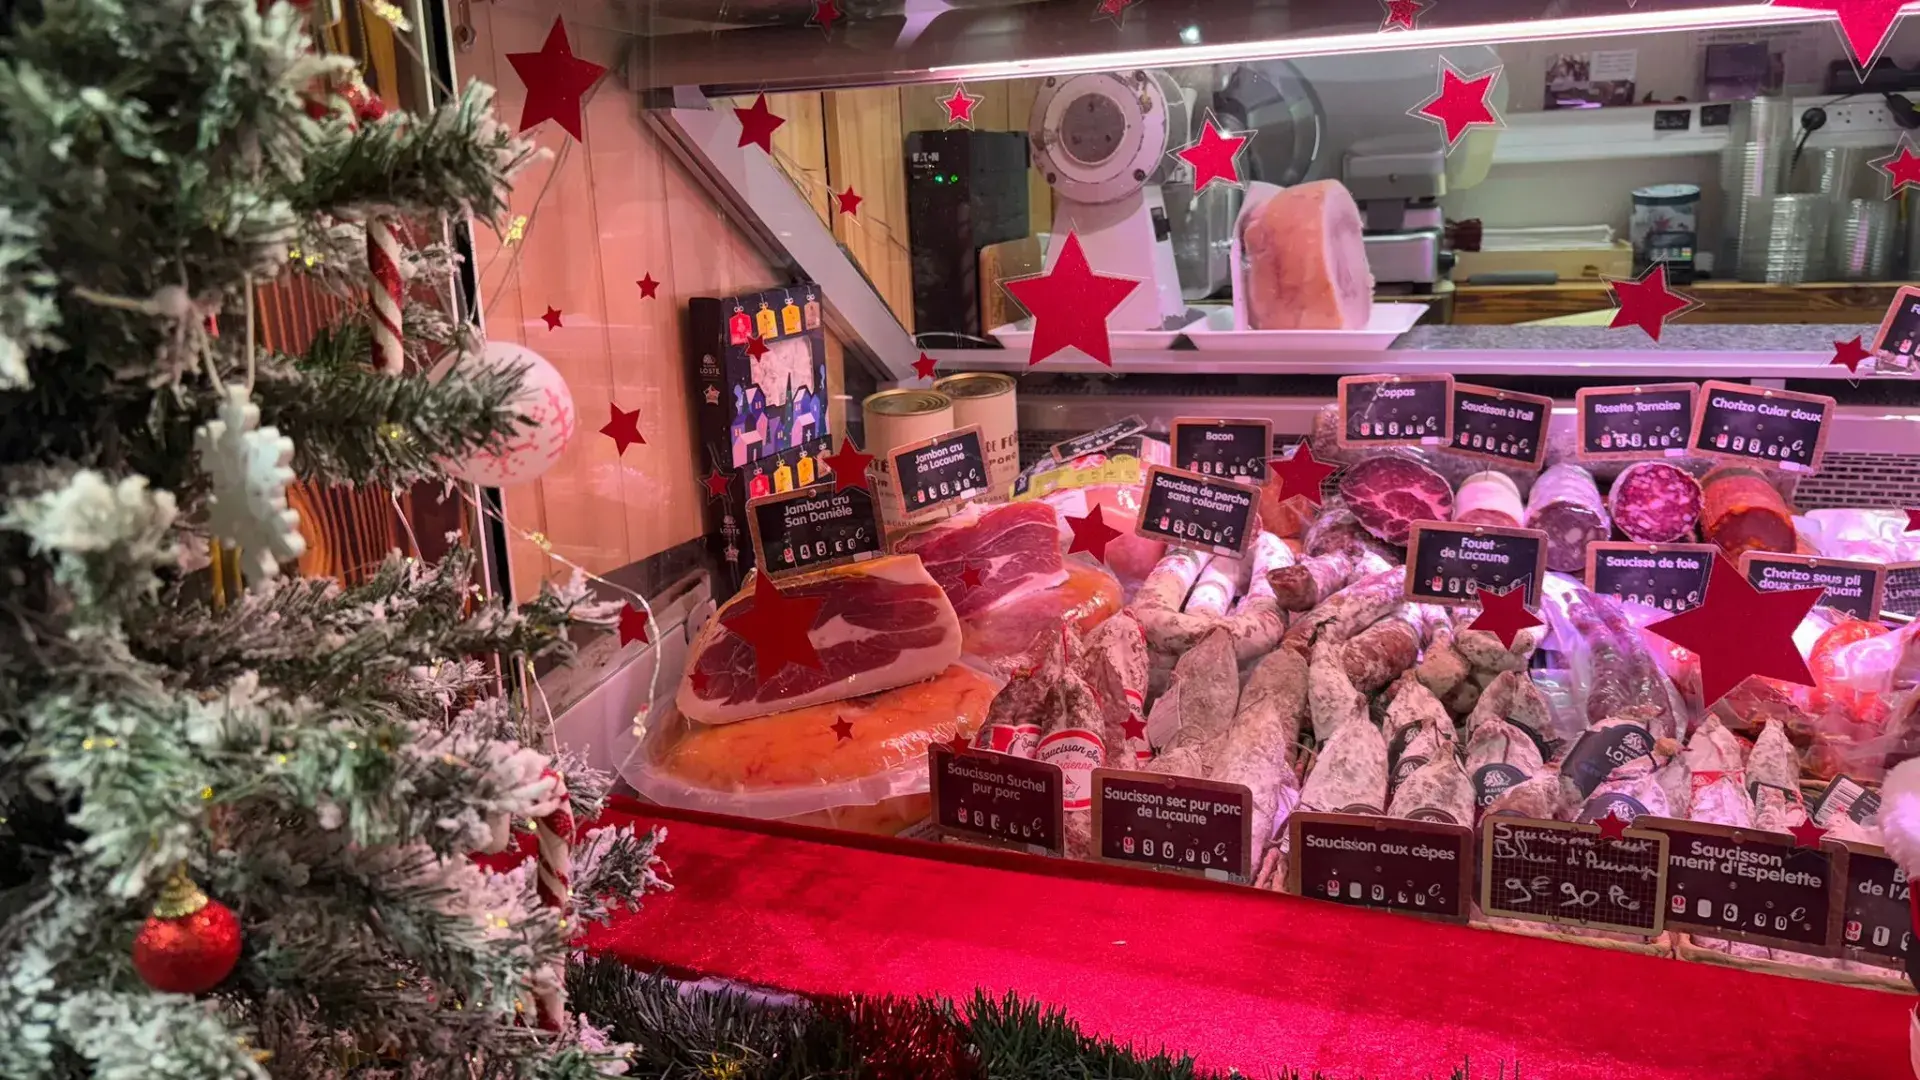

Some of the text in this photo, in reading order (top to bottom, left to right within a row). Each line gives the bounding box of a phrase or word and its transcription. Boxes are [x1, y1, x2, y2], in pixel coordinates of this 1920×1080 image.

[1375, 387, 1416, 400] Coppas
[1460, 400, 1534, 421] Saucisson à l'ail
[1594, 401, 1681, 413] Rosette Tarnaise
[1712, 397, 1822, 422] Chorizo Cular doux
[1205, 431, 1234, 441] Bacon
[914, 442, 964, 465] Jambon cru
[917, 452, 965, 473] de Lacaune
[1156, 476, 1250, 506] Saucisse de perche
[783, 495, 850, 516] Jambon cru
[1167, 491, 1234, 513] sans colorant
[784, 505, 853, 528] San Danièle
[1460, 536, 1496, 550] Fouet
[1440, 547, 1510, 564] de Lacaune
[1606, 556, 1700, 569] Saucisse de foie
[1762, 567, 1862, 586] Chorizo sous pli
[1605, 746, 1632, 765] LOS
[1618, 744, 1638, 759] MAISO
[947, 763, 1046, 793] Saucisson Suchel
[972, 782, 1021, 801] pur porc
[1104, 786, 1241, 815] Saucisson sec pur porc
[1137, 804, 1207, 825] de Lacaune
[1306, 834, 1456, 861] Saucisson aux cèpes
[1690, 840, 1783, 867] Saucisson
[1669, 854, 1823, 888] ment d'Espelette
[1858, 878, 1911, 901] de l'A
